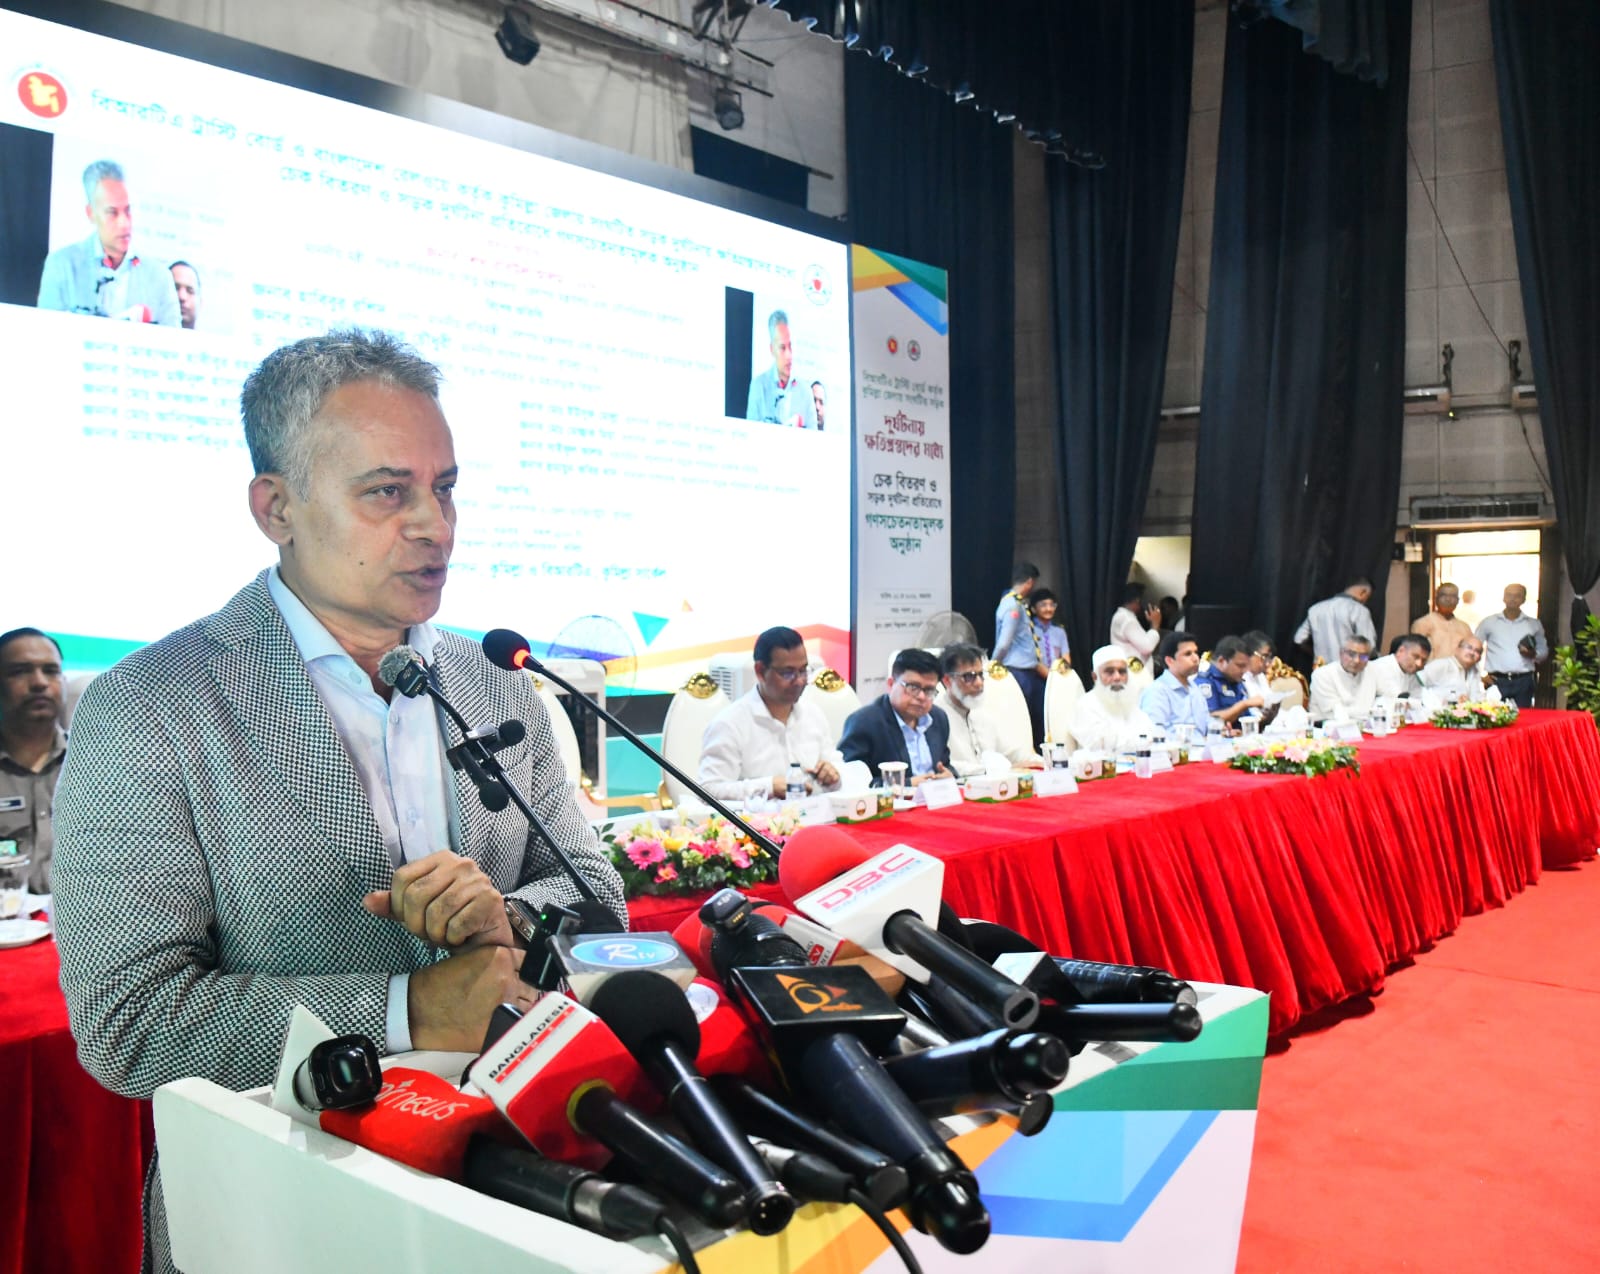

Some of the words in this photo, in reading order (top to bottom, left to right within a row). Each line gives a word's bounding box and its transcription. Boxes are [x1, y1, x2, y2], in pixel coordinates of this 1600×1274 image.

[873, 473, 893, 488] চেক
[895, 470, 926, 492] বিতরণ
[929, 480, 938, 493] ও
[865, 513, 944, 536] গণসচেতনতামূলক
[889, 532, 922, 555] অনুষ্ঠান
[816, 852, 916, 910] DBC
[489, 1001, 569, 1080] BANGLADESH
